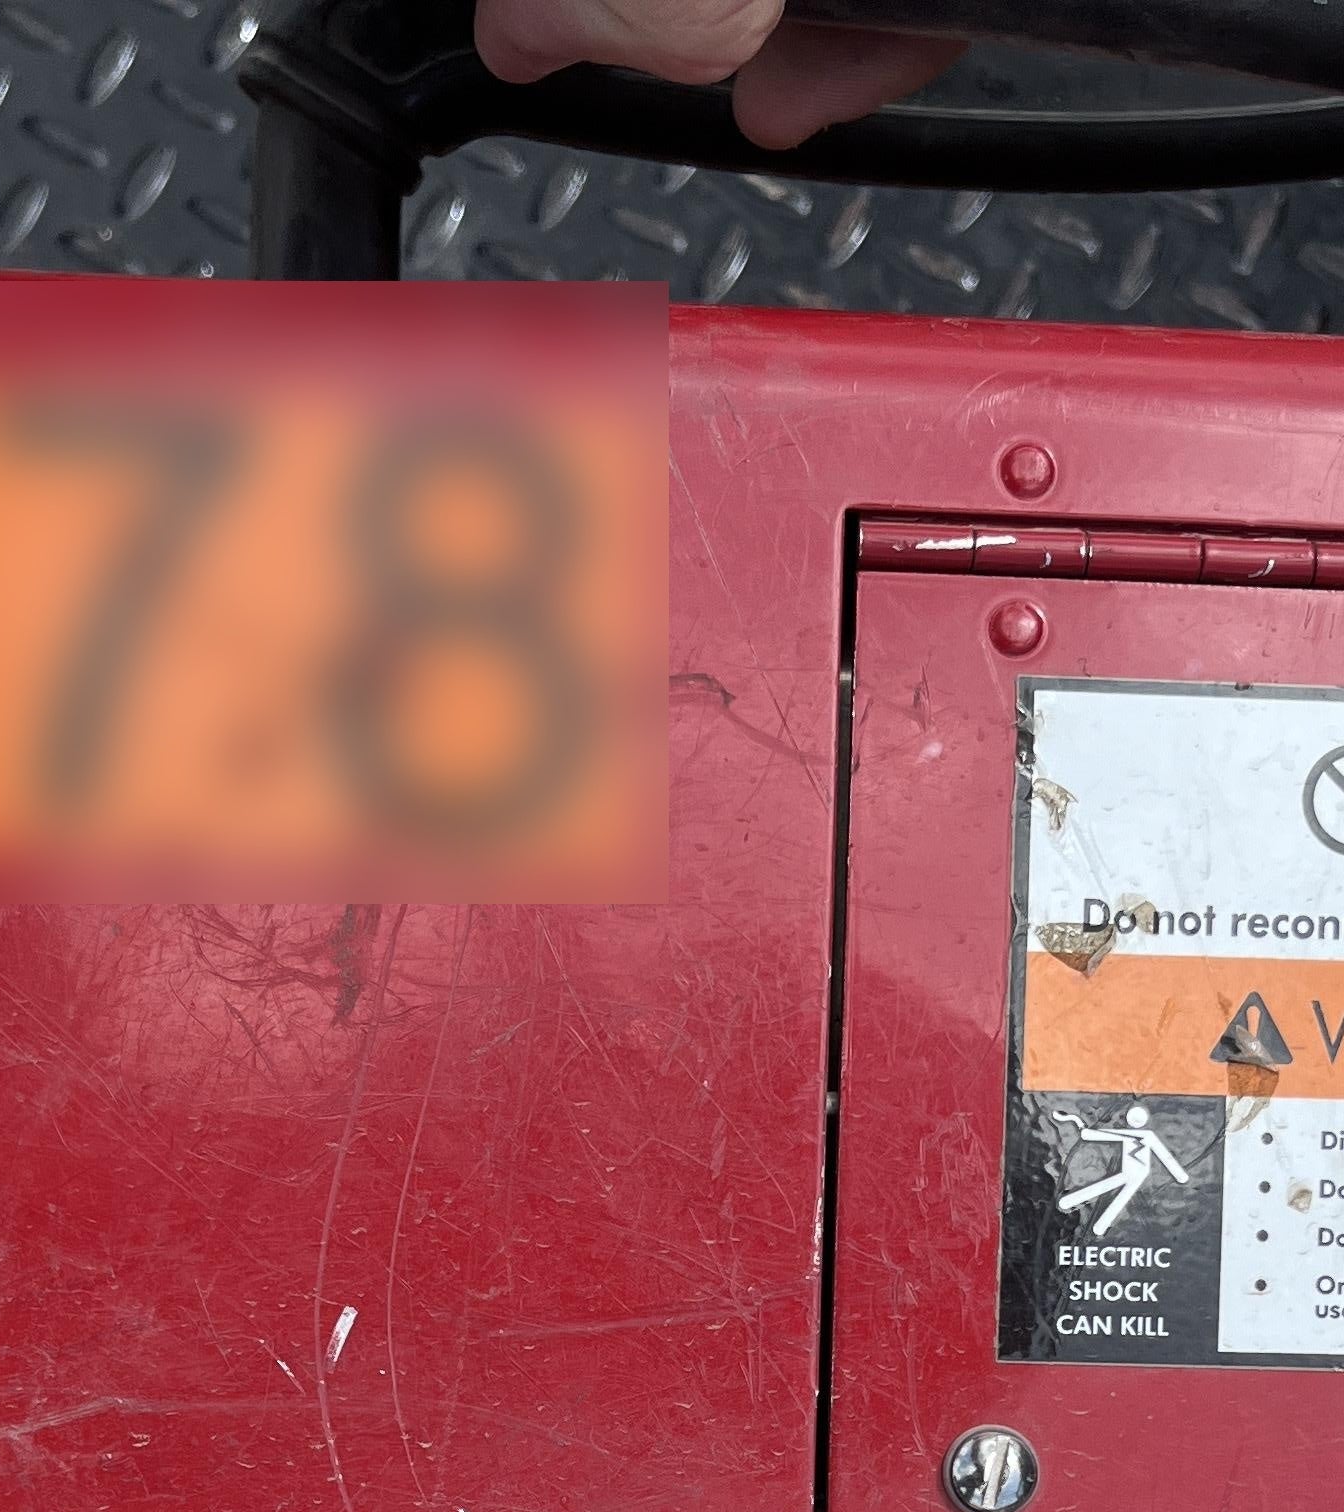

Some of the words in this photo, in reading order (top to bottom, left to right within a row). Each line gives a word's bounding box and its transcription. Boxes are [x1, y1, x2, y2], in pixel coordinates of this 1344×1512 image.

[1082, 897, 1137, 935] Do
[1154, 904, 1216, 936] not
[1058, 1245, 1172, 1268] ELECTRIC
[1069, 1280, 1159, 1302] SHOCK
[1056, 1314, 1113, 1335] CAN
[1120, 1315, 1169, 1337] KILL
